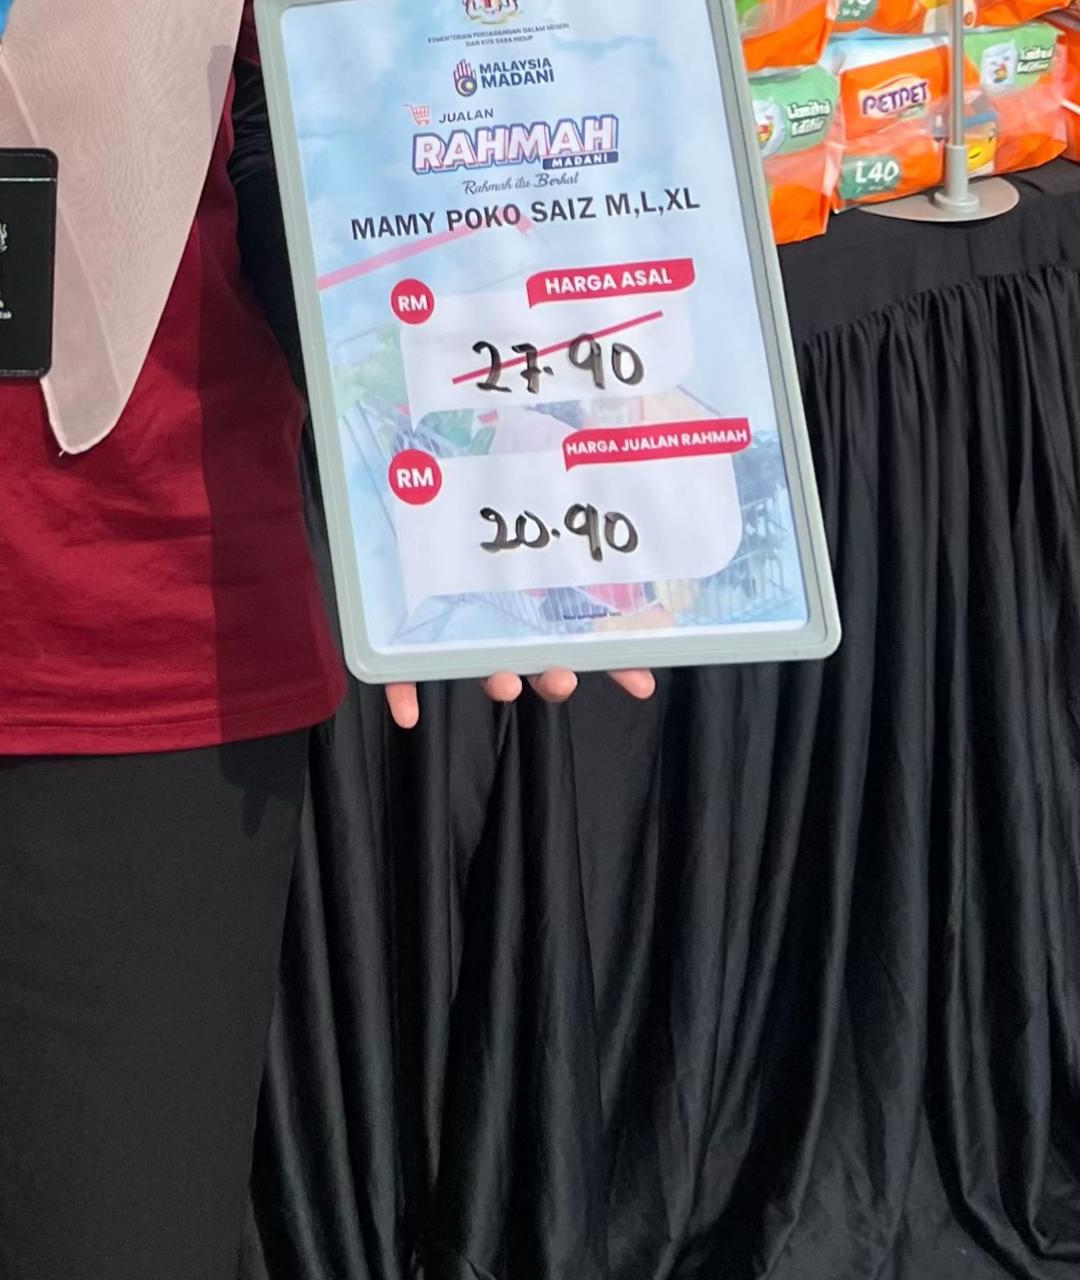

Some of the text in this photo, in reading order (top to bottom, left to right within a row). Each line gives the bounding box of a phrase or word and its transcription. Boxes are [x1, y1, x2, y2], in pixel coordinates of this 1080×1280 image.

[523, 25, 546, 35] DALAM
[479, 57, 553, 75] MALAYSIA
[480, 68, 555, 90] MADANI
[787, 98, 832, 120] Limited
[862, 82, 928, 116] PETPET
[438, 108, 495, 124] JUALAN
[412, 114, 620, 175] RAHMAH
[551, 153, 609, 169] MADANI
[855, 160, 900, 184] L40
[462, 178, 512, 195] Rahmah
[534, 171, 580, 189] Berkat
[351, 187, 701, 241] MAMY POKO SAIZ M,L,XL
[545, 268, 673, 296] HARGA ASAL
[397, 293, 429, 312] RM
[472, 332, 646, 394] 27.90
[565, 427, 748, 456] HARGA JUALAN RAHMAH
[395, 468, 434, 487] RM
[479, 501, 639, 562] 20.90
